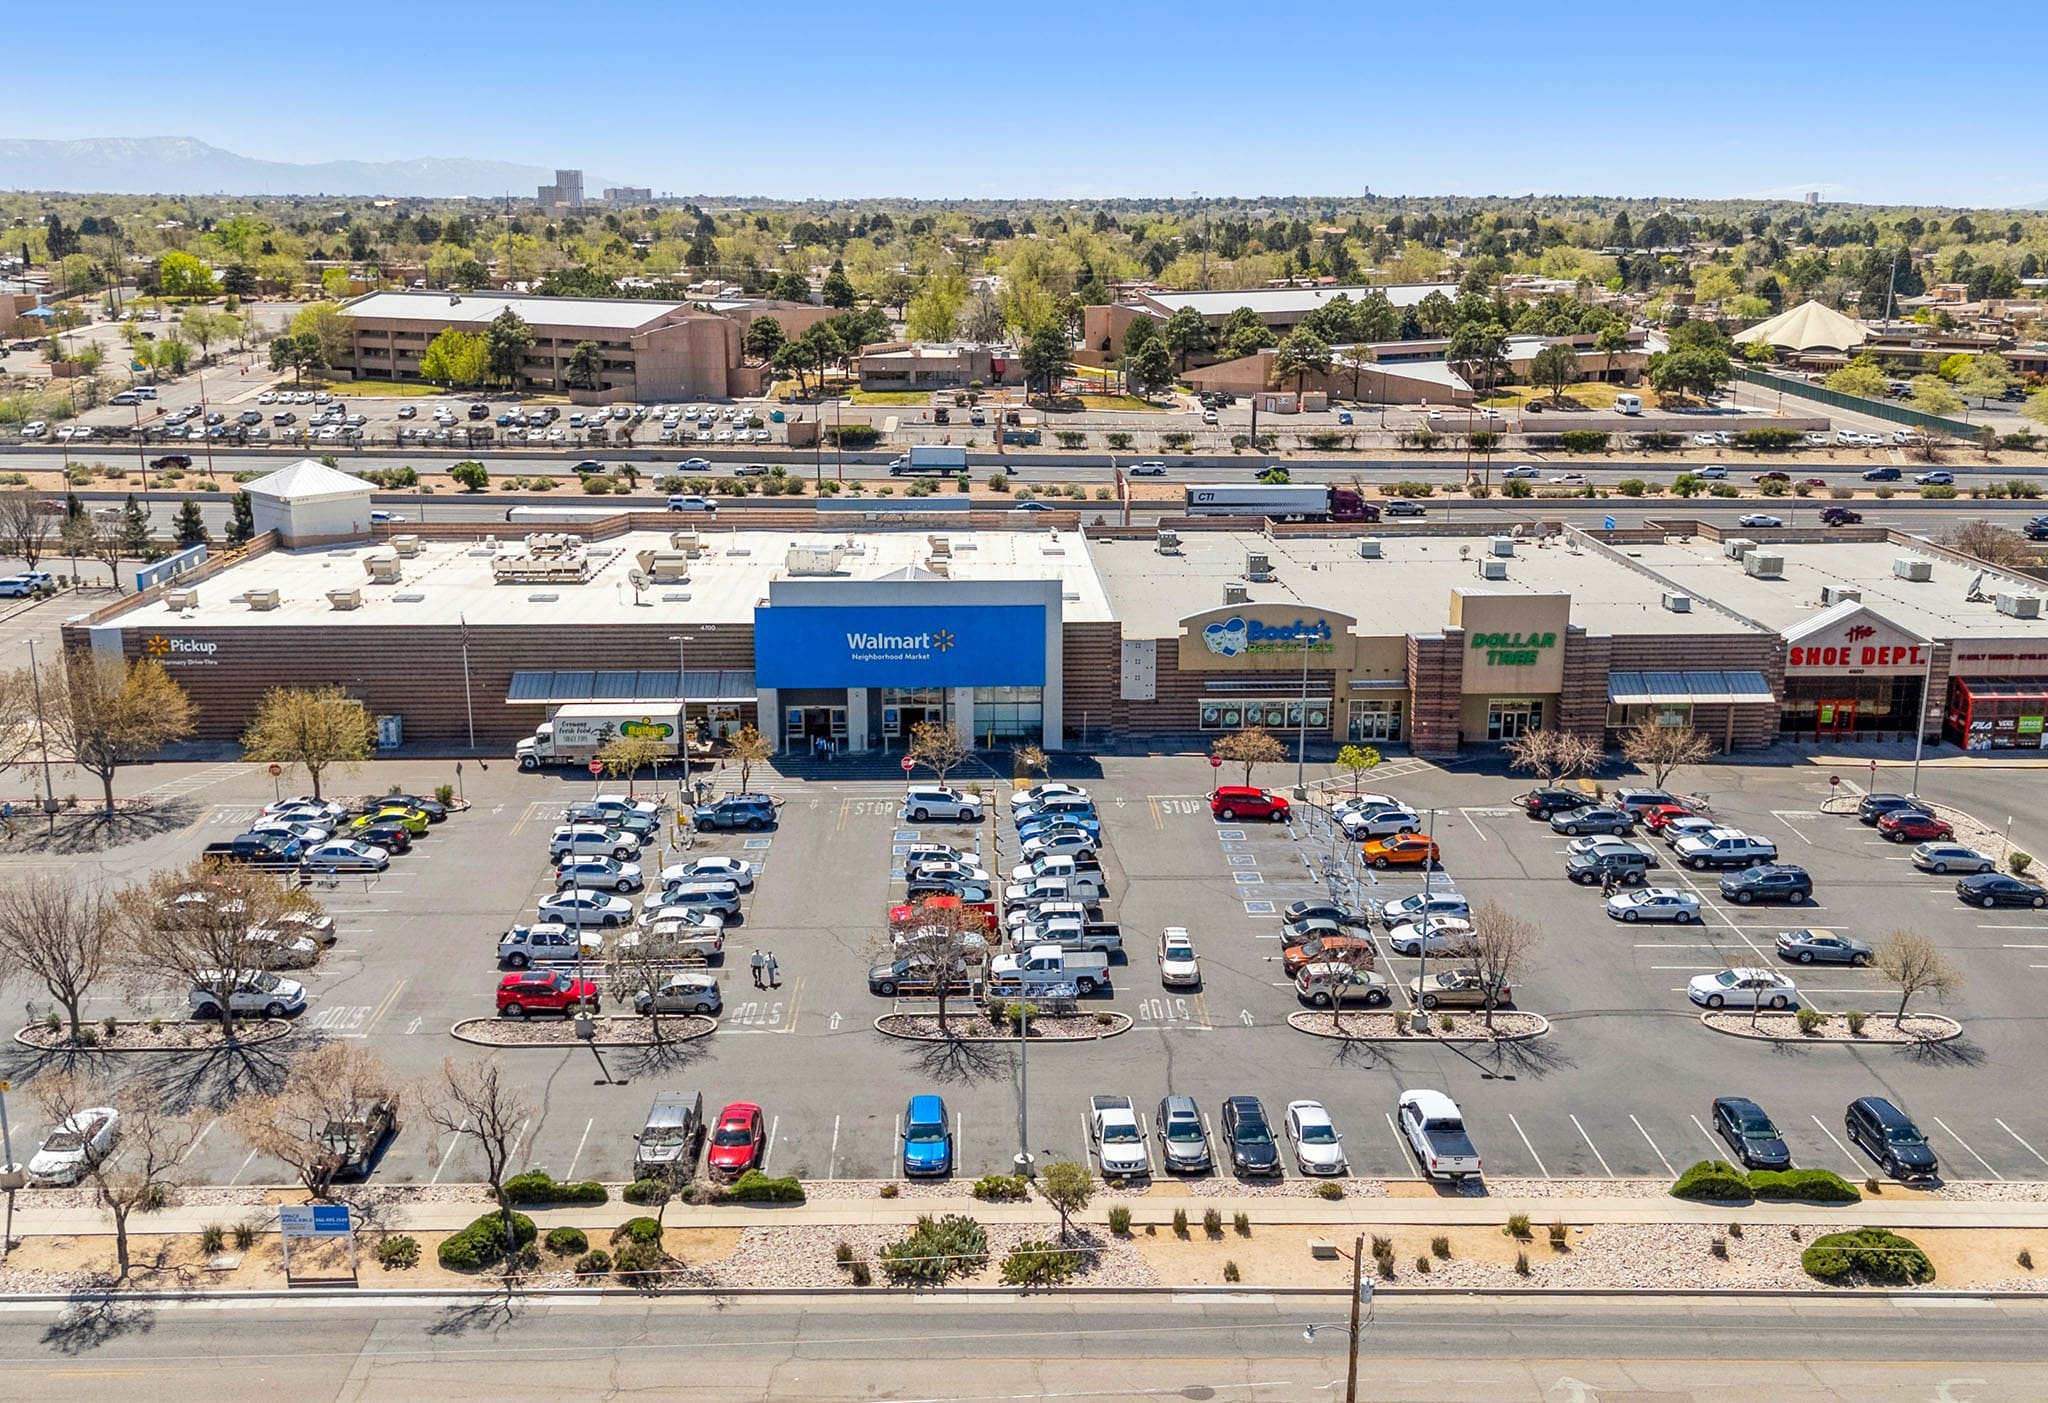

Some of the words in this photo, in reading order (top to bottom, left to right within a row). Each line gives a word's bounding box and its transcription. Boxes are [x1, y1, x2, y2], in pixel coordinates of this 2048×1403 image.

[1198, 493, 1215, 501] CTI
[170, 639, 217, 655] Pickup
[847, 632, 930, 649] Walmart
[1471, 632, 1557, 649] DOLLAR
[852, 653, 903, 661] Neighborhood
[1487, 650, 1539, 666] TREE
[1790, 647, 1851, 665] SHOE
[1861, 646, 1926, 665] DEPT.
[1970, 721, 1993, 730] FILA
[855, 802, 893, 815] STOP
[1161, 800, 1200, 814] STOP
[730, 1002, 783, 1025] STOP
[1139, 999, 1190, 1020] STOP
[307, 1007, 371, 1029] STOP
